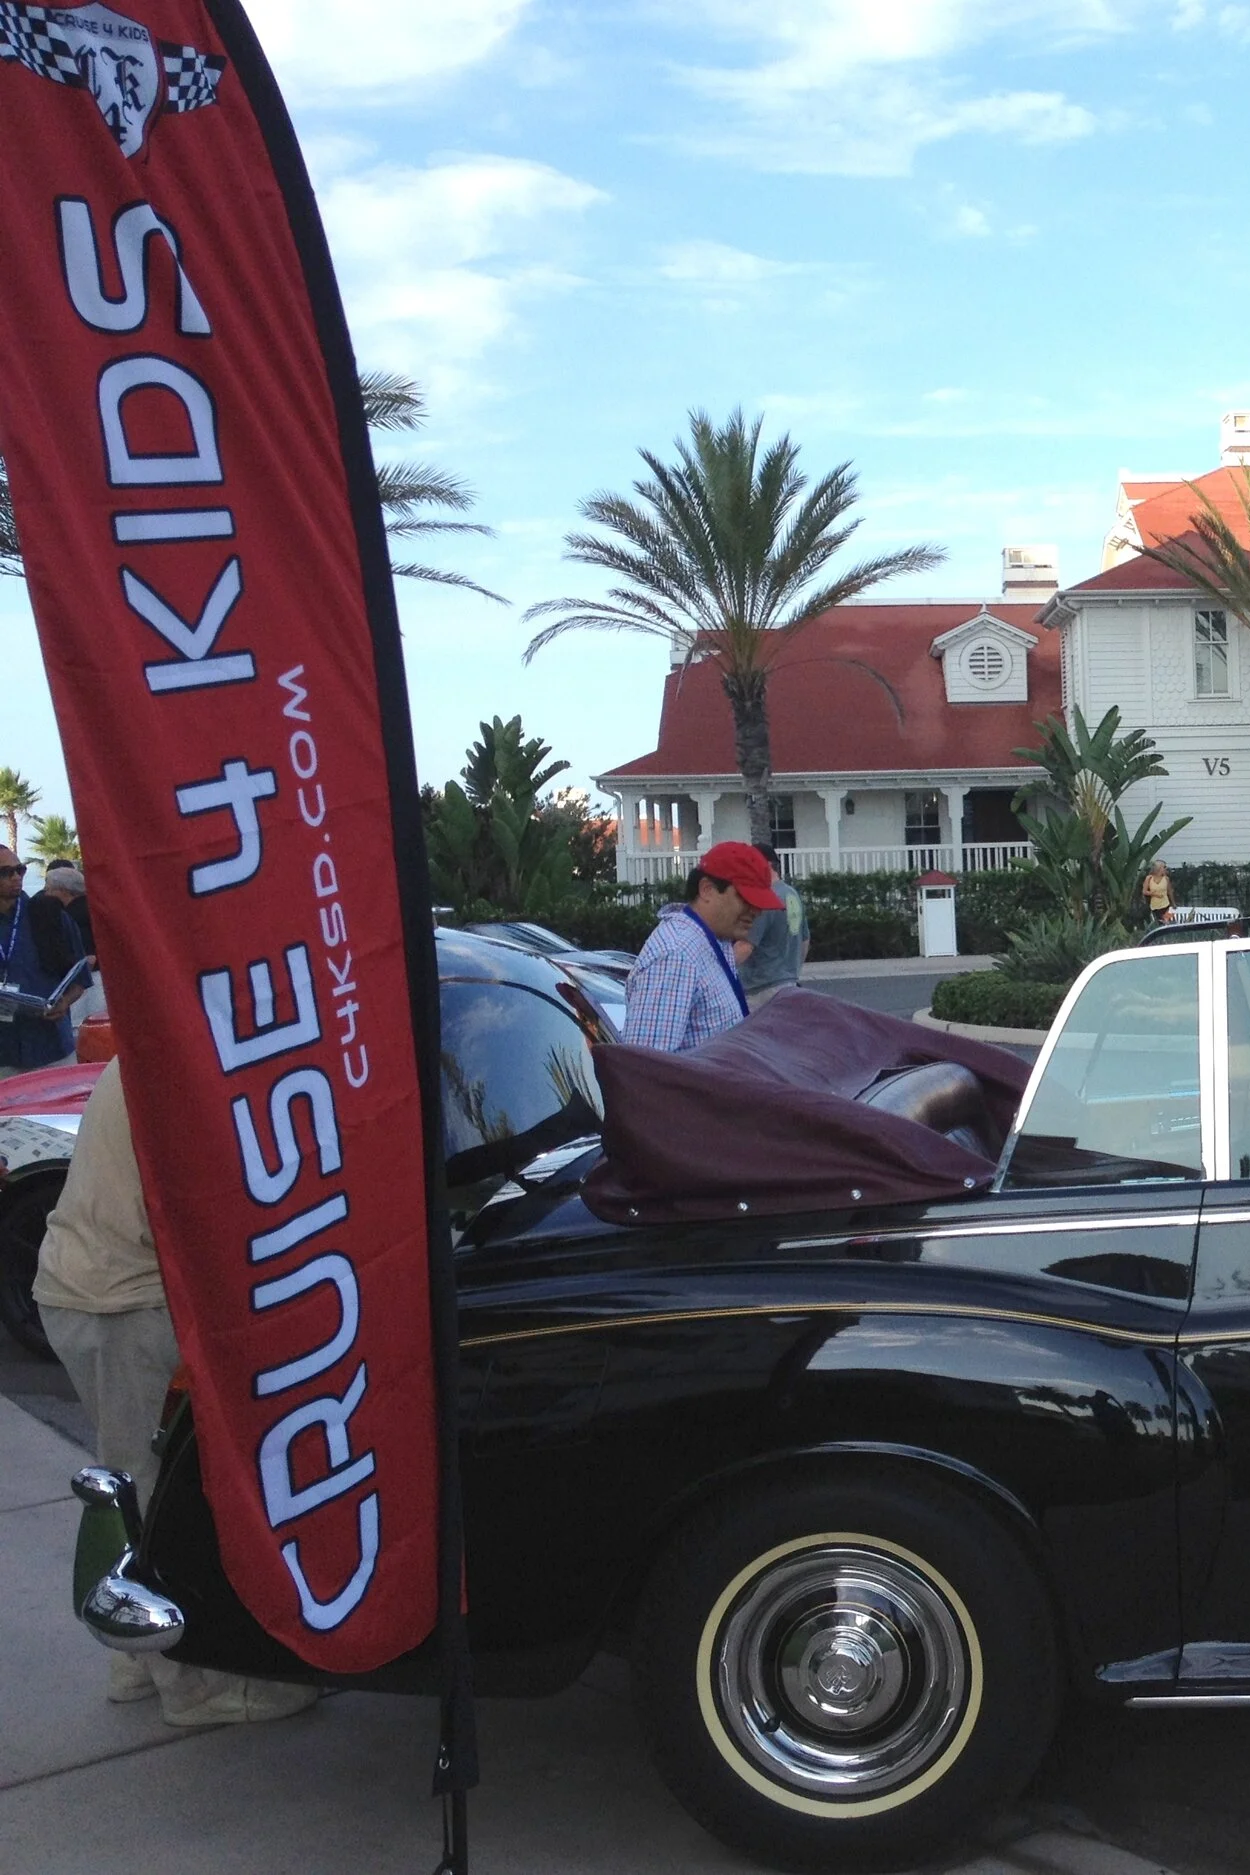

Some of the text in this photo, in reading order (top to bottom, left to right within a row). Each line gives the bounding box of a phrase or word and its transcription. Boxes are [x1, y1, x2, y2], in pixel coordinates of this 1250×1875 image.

[102, 22, 113, 36] 4
[117, 25, 150, 42] KIDS
[277, 664, 370, 1088] C4KSD.COM
[1202, 757, 1230, 776] V5
[54, 194, 381, 1634] CRUISE 4 KIDS
